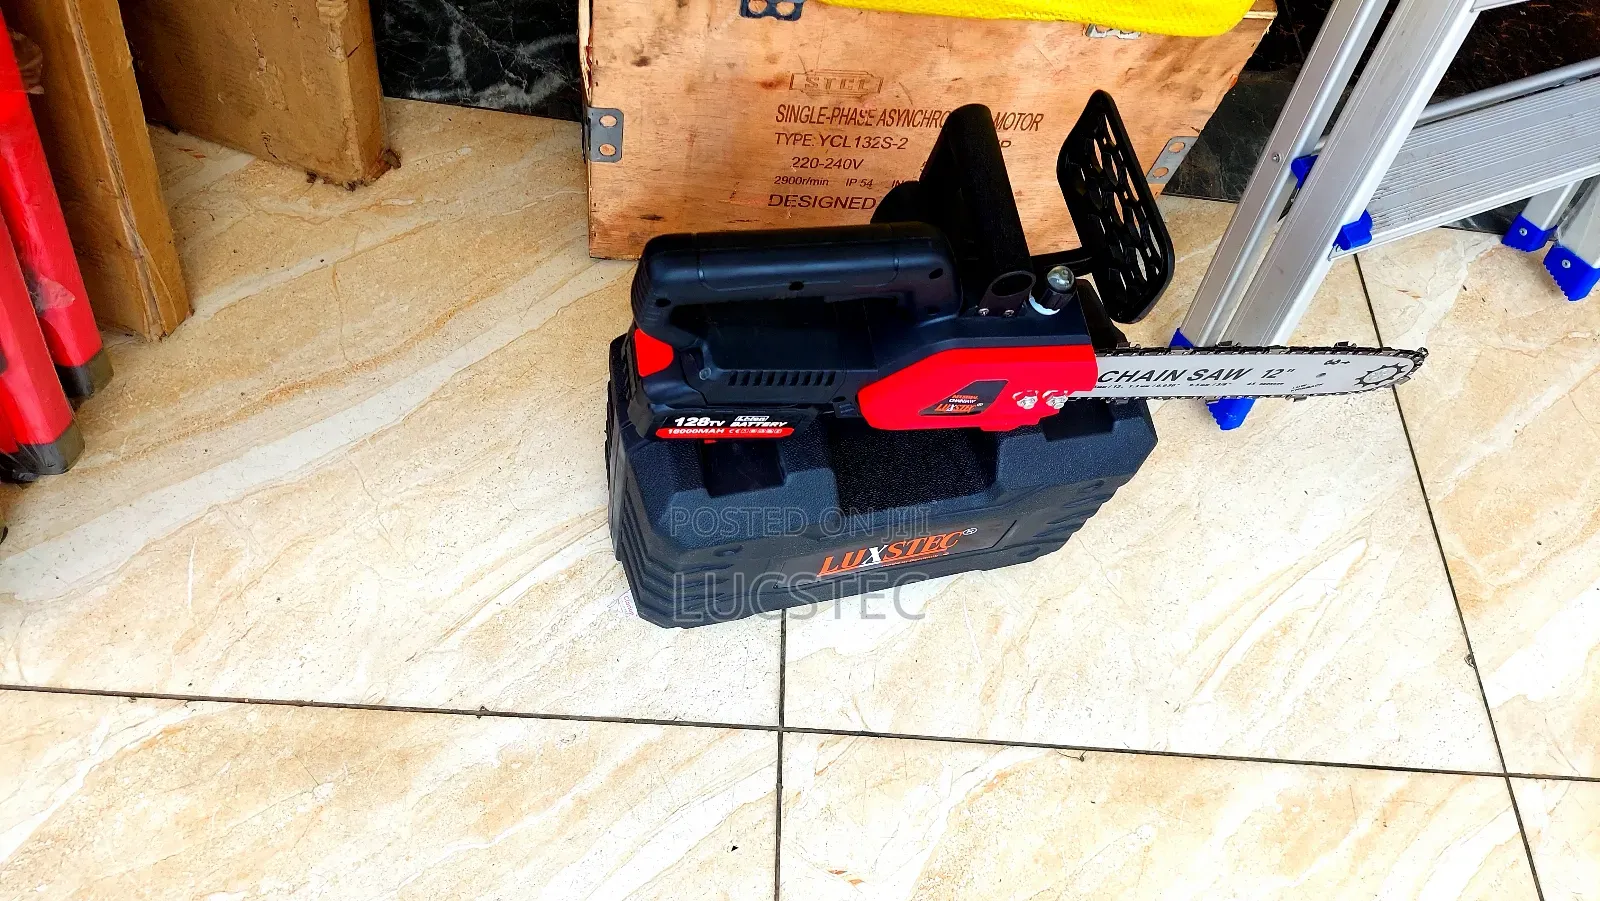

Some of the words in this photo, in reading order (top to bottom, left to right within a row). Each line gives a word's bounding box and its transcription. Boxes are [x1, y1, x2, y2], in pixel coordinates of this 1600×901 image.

[775, 104, 878, 127] SINGLE-PHASE
[818, 134, 909, 150] YCL132S-2
[791, 156, 865, 170] 220-240V
[773, 175, 829, 187] 2900r/min
[845, 177, 858, 187] IP
[859, 178, 874, 189] 54
[767, 194, 877, 210] DESIGNED
[1097, 370, 1188, 383] CHAIN
[1186, 367, 1253, 382] SAW
[816, 531, 963, 577] LUXSTEC
